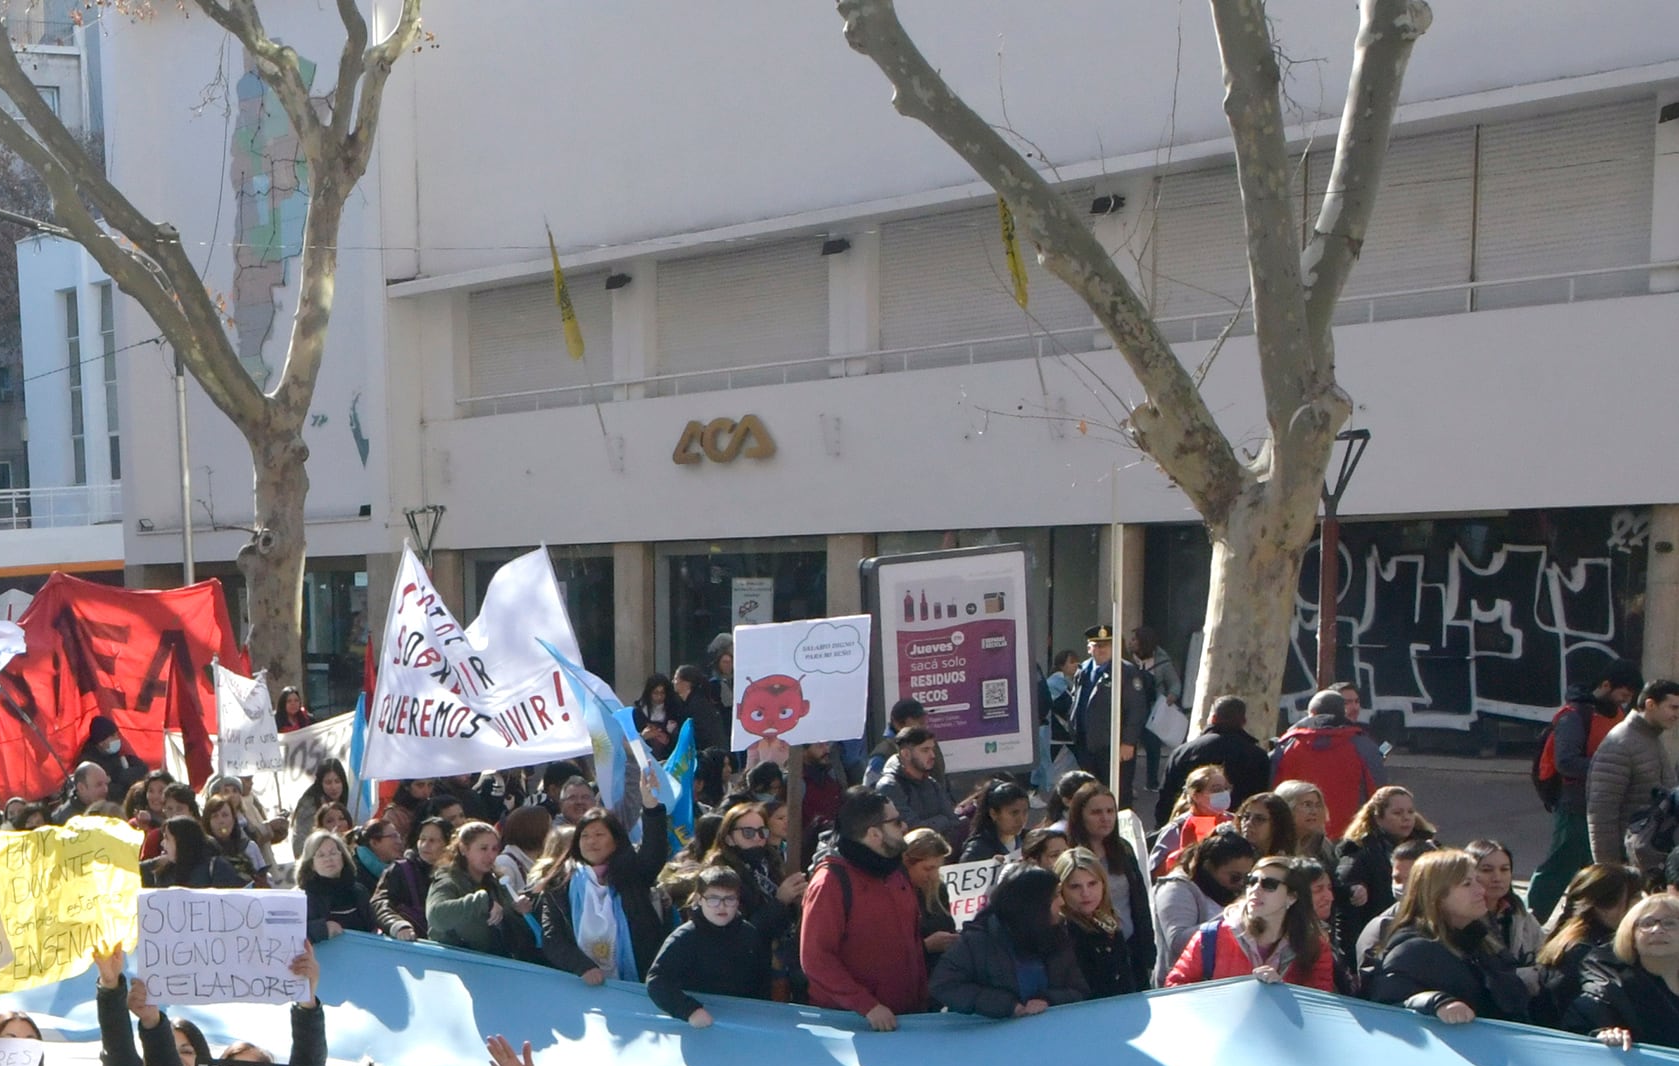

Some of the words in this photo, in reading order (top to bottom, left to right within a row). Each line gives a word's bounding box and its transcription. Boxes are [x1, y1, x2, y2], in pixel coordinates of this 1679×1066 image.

[672, 414, 777, 465] ACA
[910, 643, 953, 656] Jueves
[911, 660, 938, 672] sacá
[942, 656, 967, 668] solo
[910, 671, 966, 688] RESIDUOS
[912, 689, 949, 704] SECOS
[377, 692, 491, 739] QUEREMOS
[6, 829, 55, 872] HOY
[141, 894, 265, 934] SUELDO
[144, 938, 226, 968] DIGNO
[236, 935, 304, 966] PARA
[146, 971, 306, 999] CELADORES
